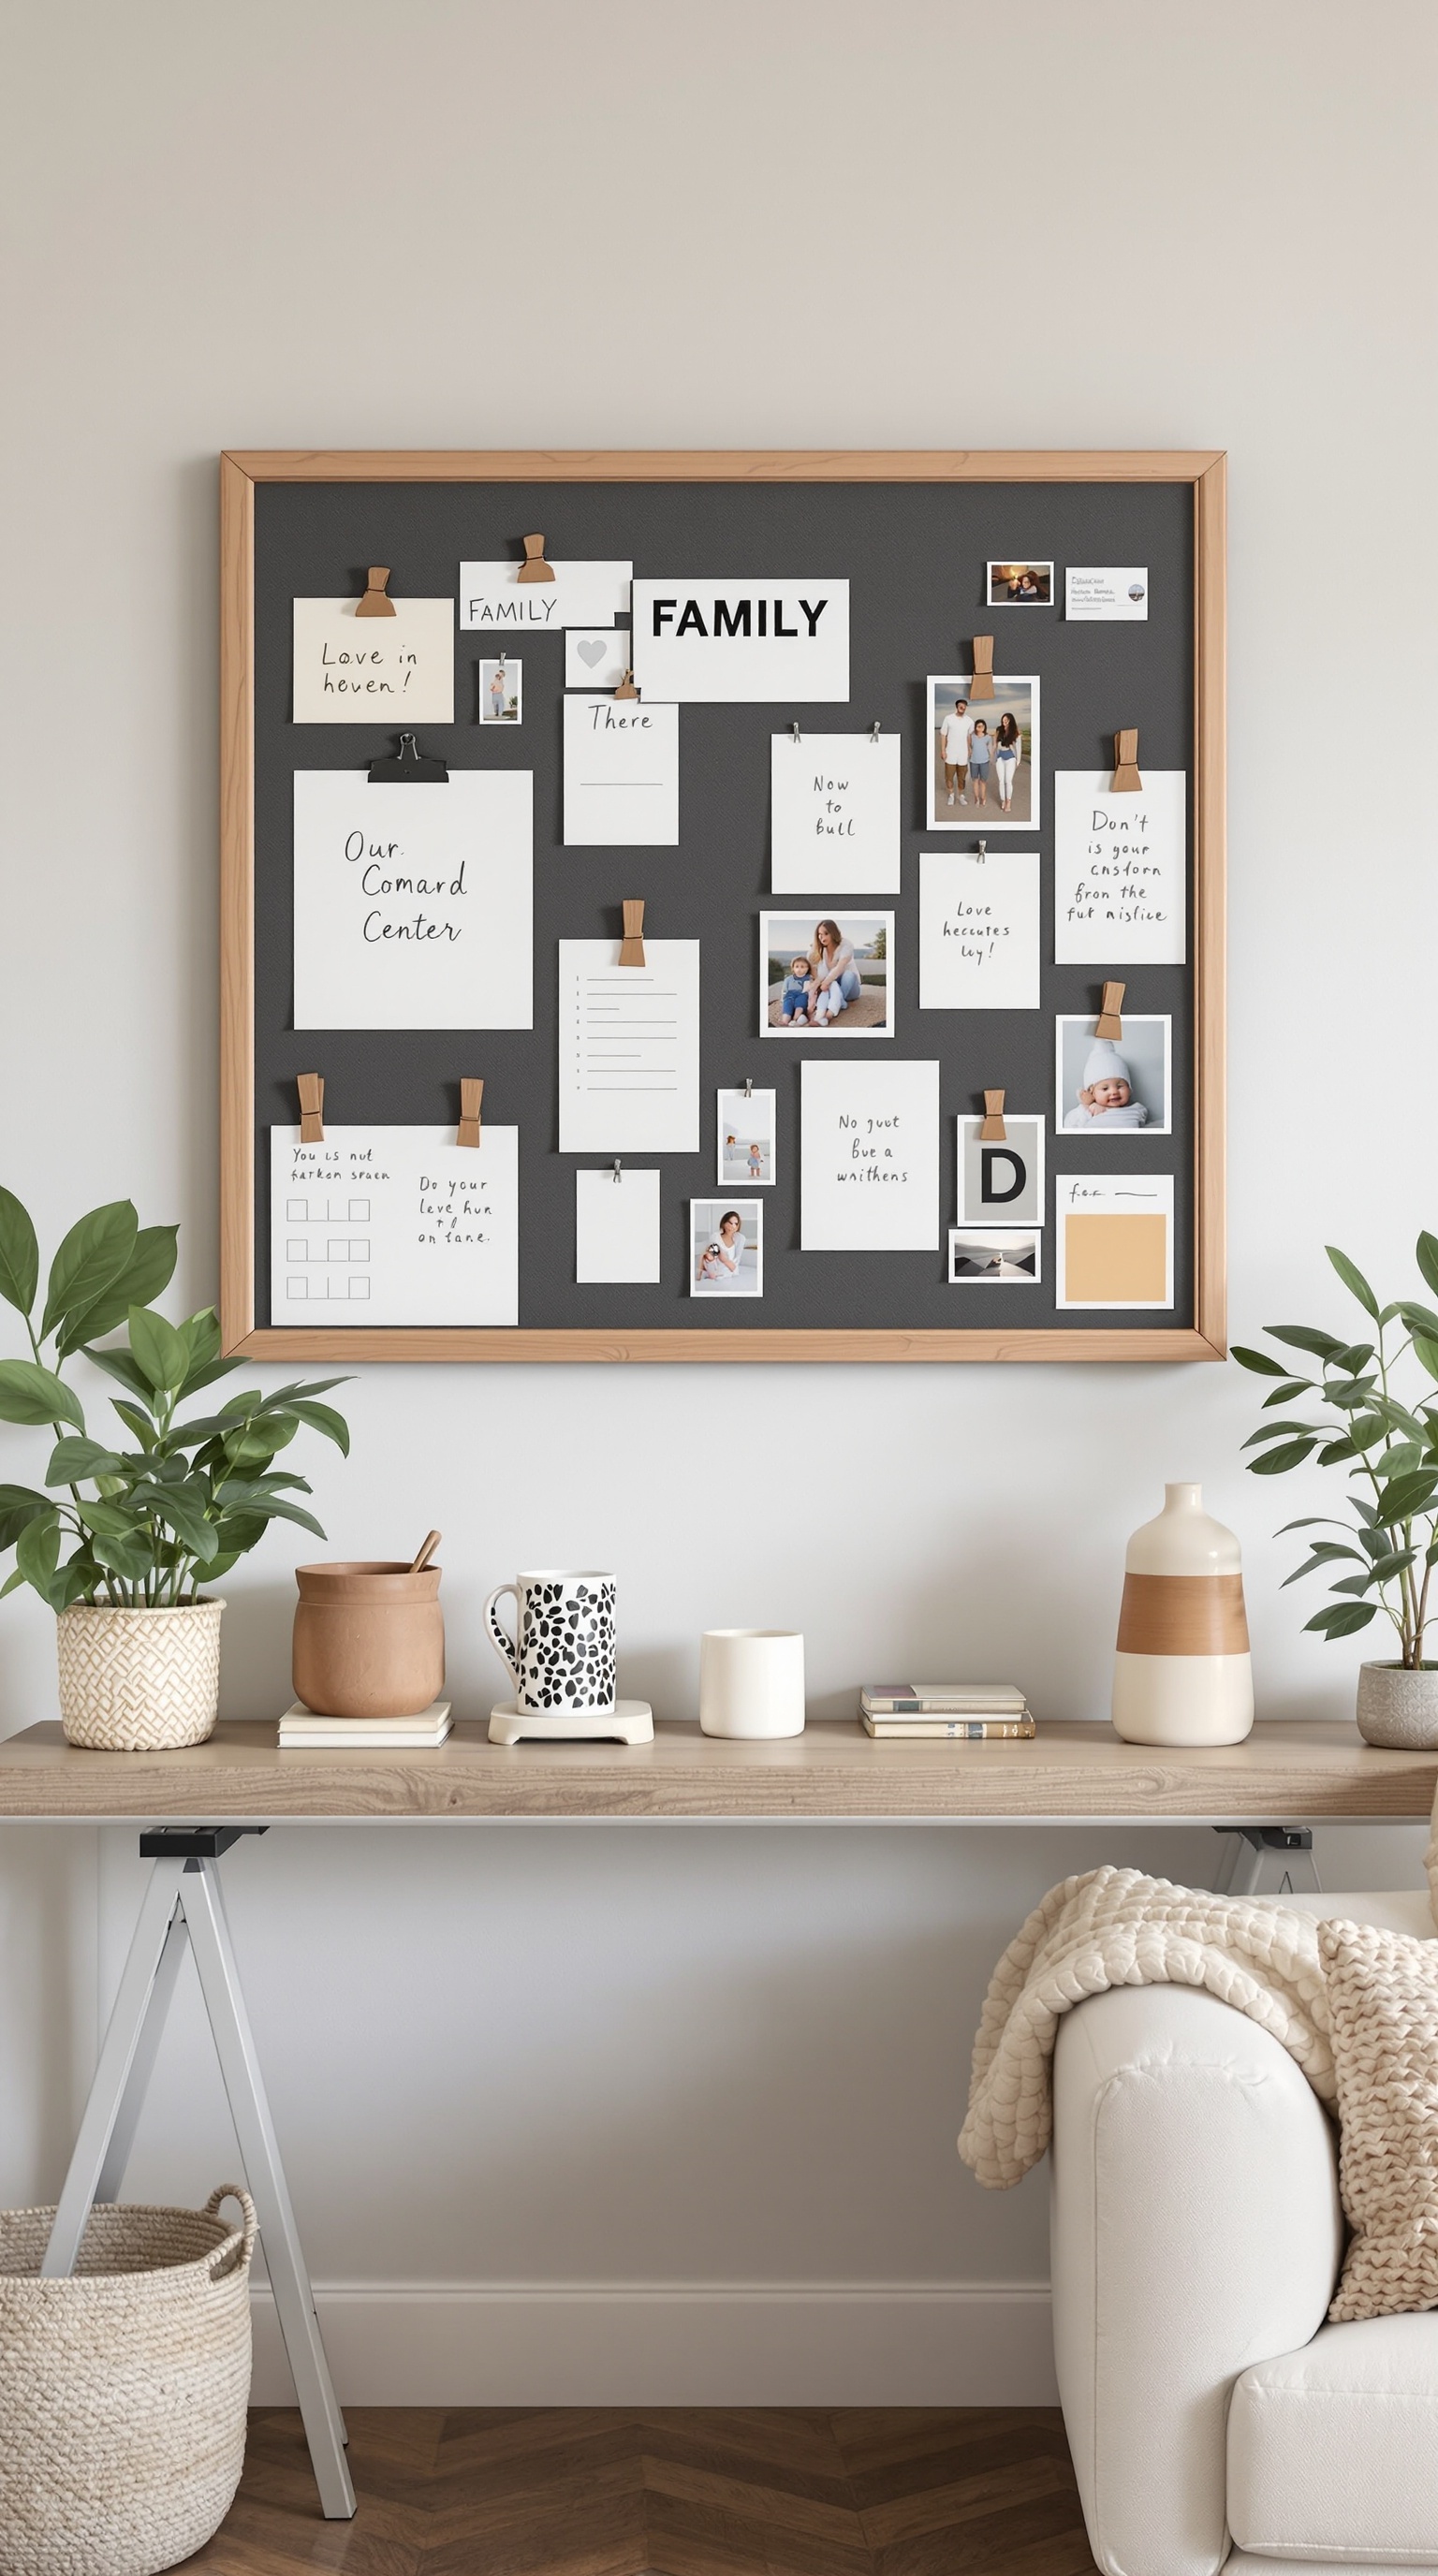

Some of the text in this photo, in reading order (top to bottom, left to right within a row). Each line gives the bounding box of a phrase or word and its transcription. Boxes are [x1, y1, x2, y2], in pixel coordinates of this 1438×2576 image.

[468, 597, 558, 622] FAMILY
[652, 598, 829, 637] FAMILY
[399, 644, 418, 666] in
[586, 704, 653, 731] There
[813, 774, 849, 792] Now
[825, 798, 843, 814] to
[1092, 810, 1150, 833] Don't
[1088, 841, 1151, 860] is your
[1120, 884, 1148, 900] the
[957, 900, 992, 917] Love
[362, 910, 462, 943] Center
[838, 1114, 858, 1130] No
[292, 1148, 316, 1164] You
[884, 1148, 893, 1158] a
[980, 1148, 1027, 1204] D
[419, 1176, 488, 1198] Do your
